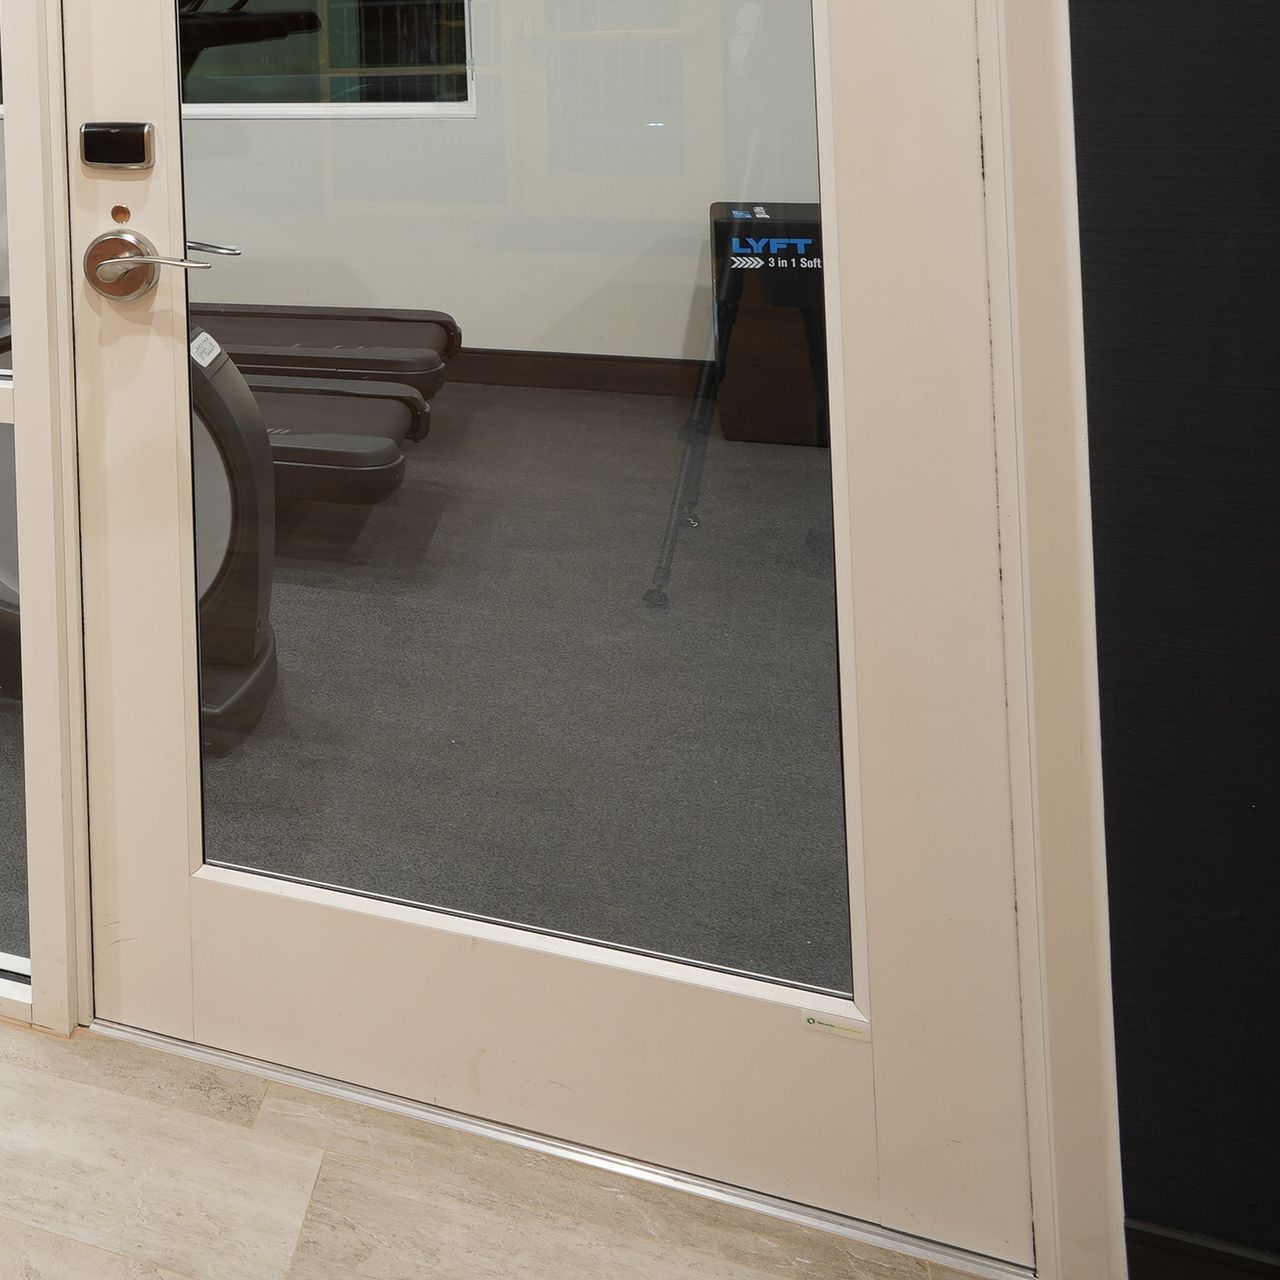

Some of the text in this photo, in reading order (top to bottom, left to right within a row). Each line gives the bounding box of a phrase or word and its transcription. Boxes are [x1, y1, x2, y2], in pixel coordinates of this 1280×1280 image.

[731, 237, 813, 255] LYFT
[768, 257, 822, 269] 3 in 1 Soft
